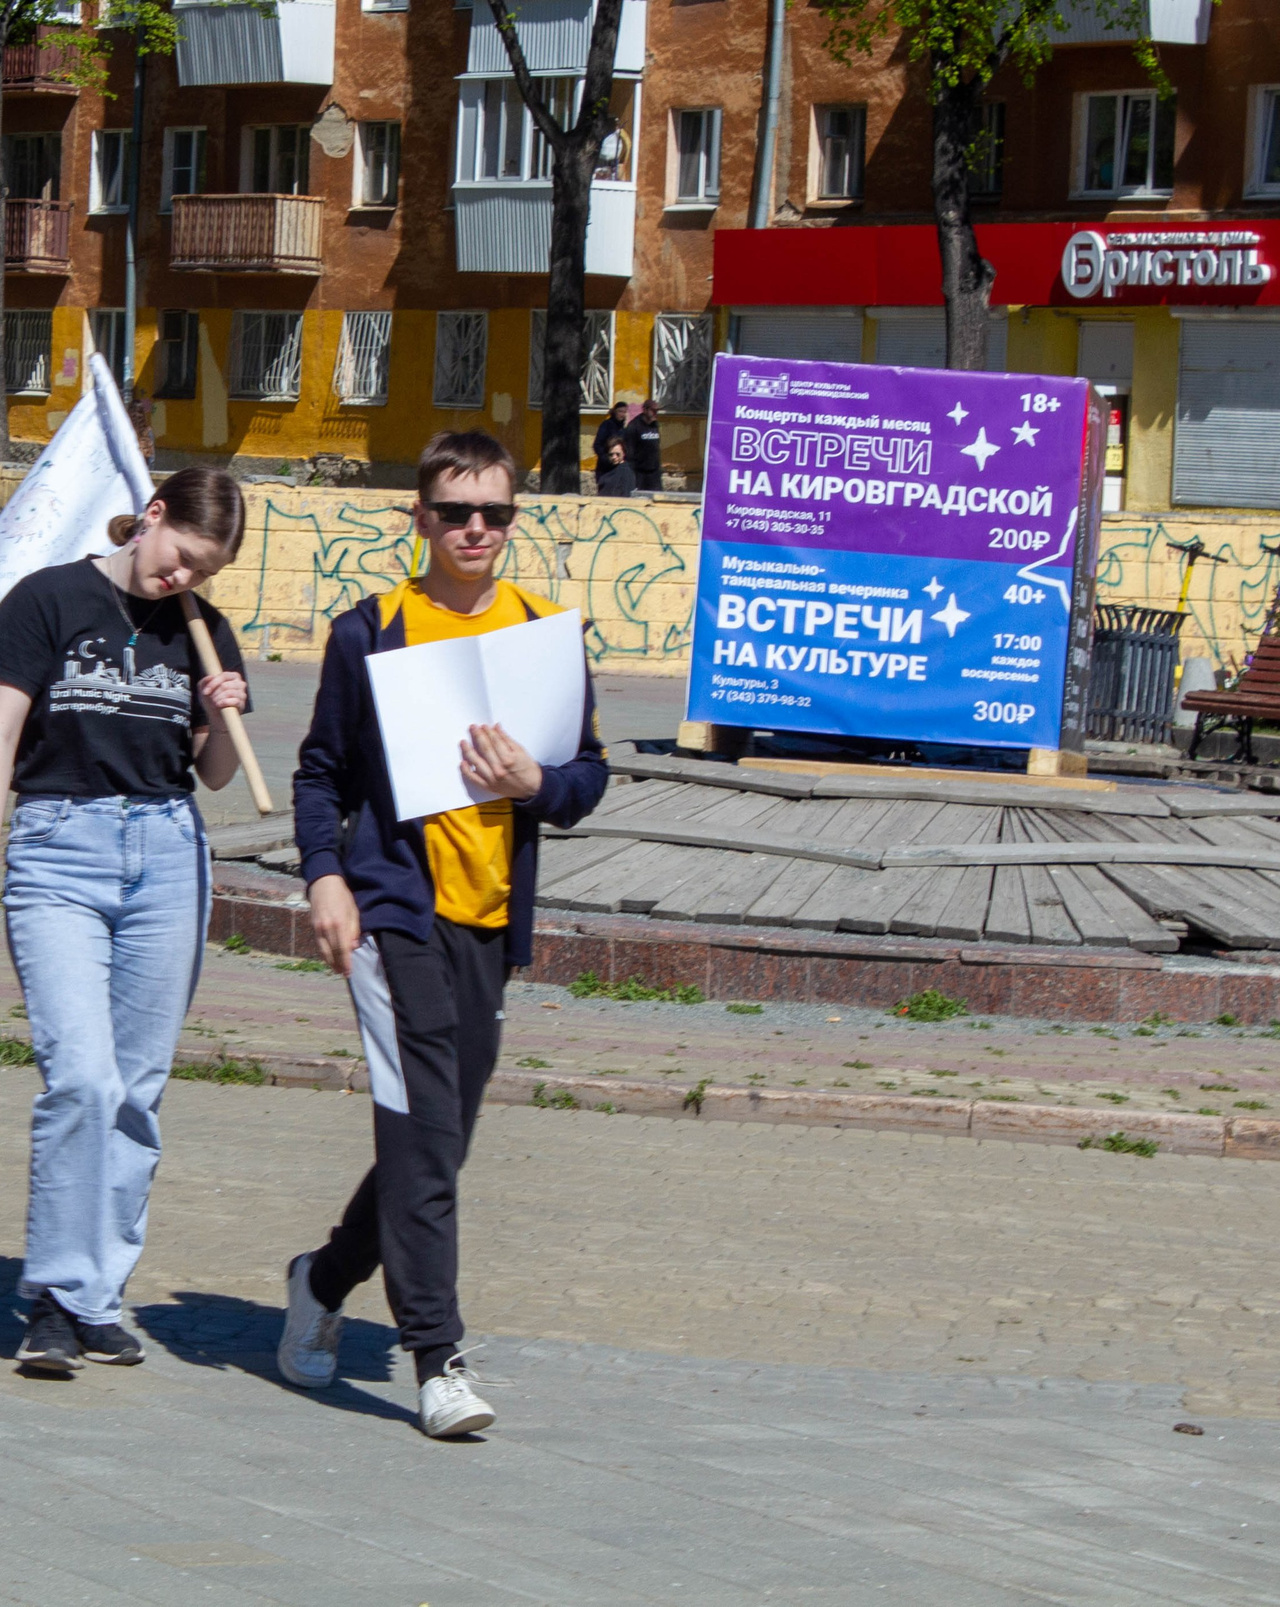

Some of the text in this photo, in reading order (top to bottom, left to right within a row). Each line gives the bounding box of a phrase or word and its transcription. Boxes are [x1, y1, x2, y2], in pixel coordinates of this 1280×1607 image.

[1061, 230, 1271, 299] Бристоль
[1020, 393, 1061, 413] 18+
[735, 405, 931, 434] Концерты каждый месяц
[731, 426, 933, 475] ВСТРЕЧИ
[728, 469, 1053, 517] НА КИРОВГРАДСКОЙ
[726, 503, 831, 522] Кировградская, 11
[725, 518, 825, 535] +7 (343) 305-30-35
[722, 555, 826, 576] Музыкально-
[721, 574, 909, 600] танцевальная вечеринка
[1002, 584, 1046, 605] 40+
[716, 594, 924, 645] ВСТРЕЧИ
[992, 633, 1042, 651] 17:00
[713, 640, 929, 682] НА КУЛЬТУРЕ
[991, 655, 1041, 669] каждое
[711, 674, 779, 690] Культуры, 3
[960, 668, 1040, 683] воскресенье
[710, 690, 812, 708] +7 (343) 379-98-32
